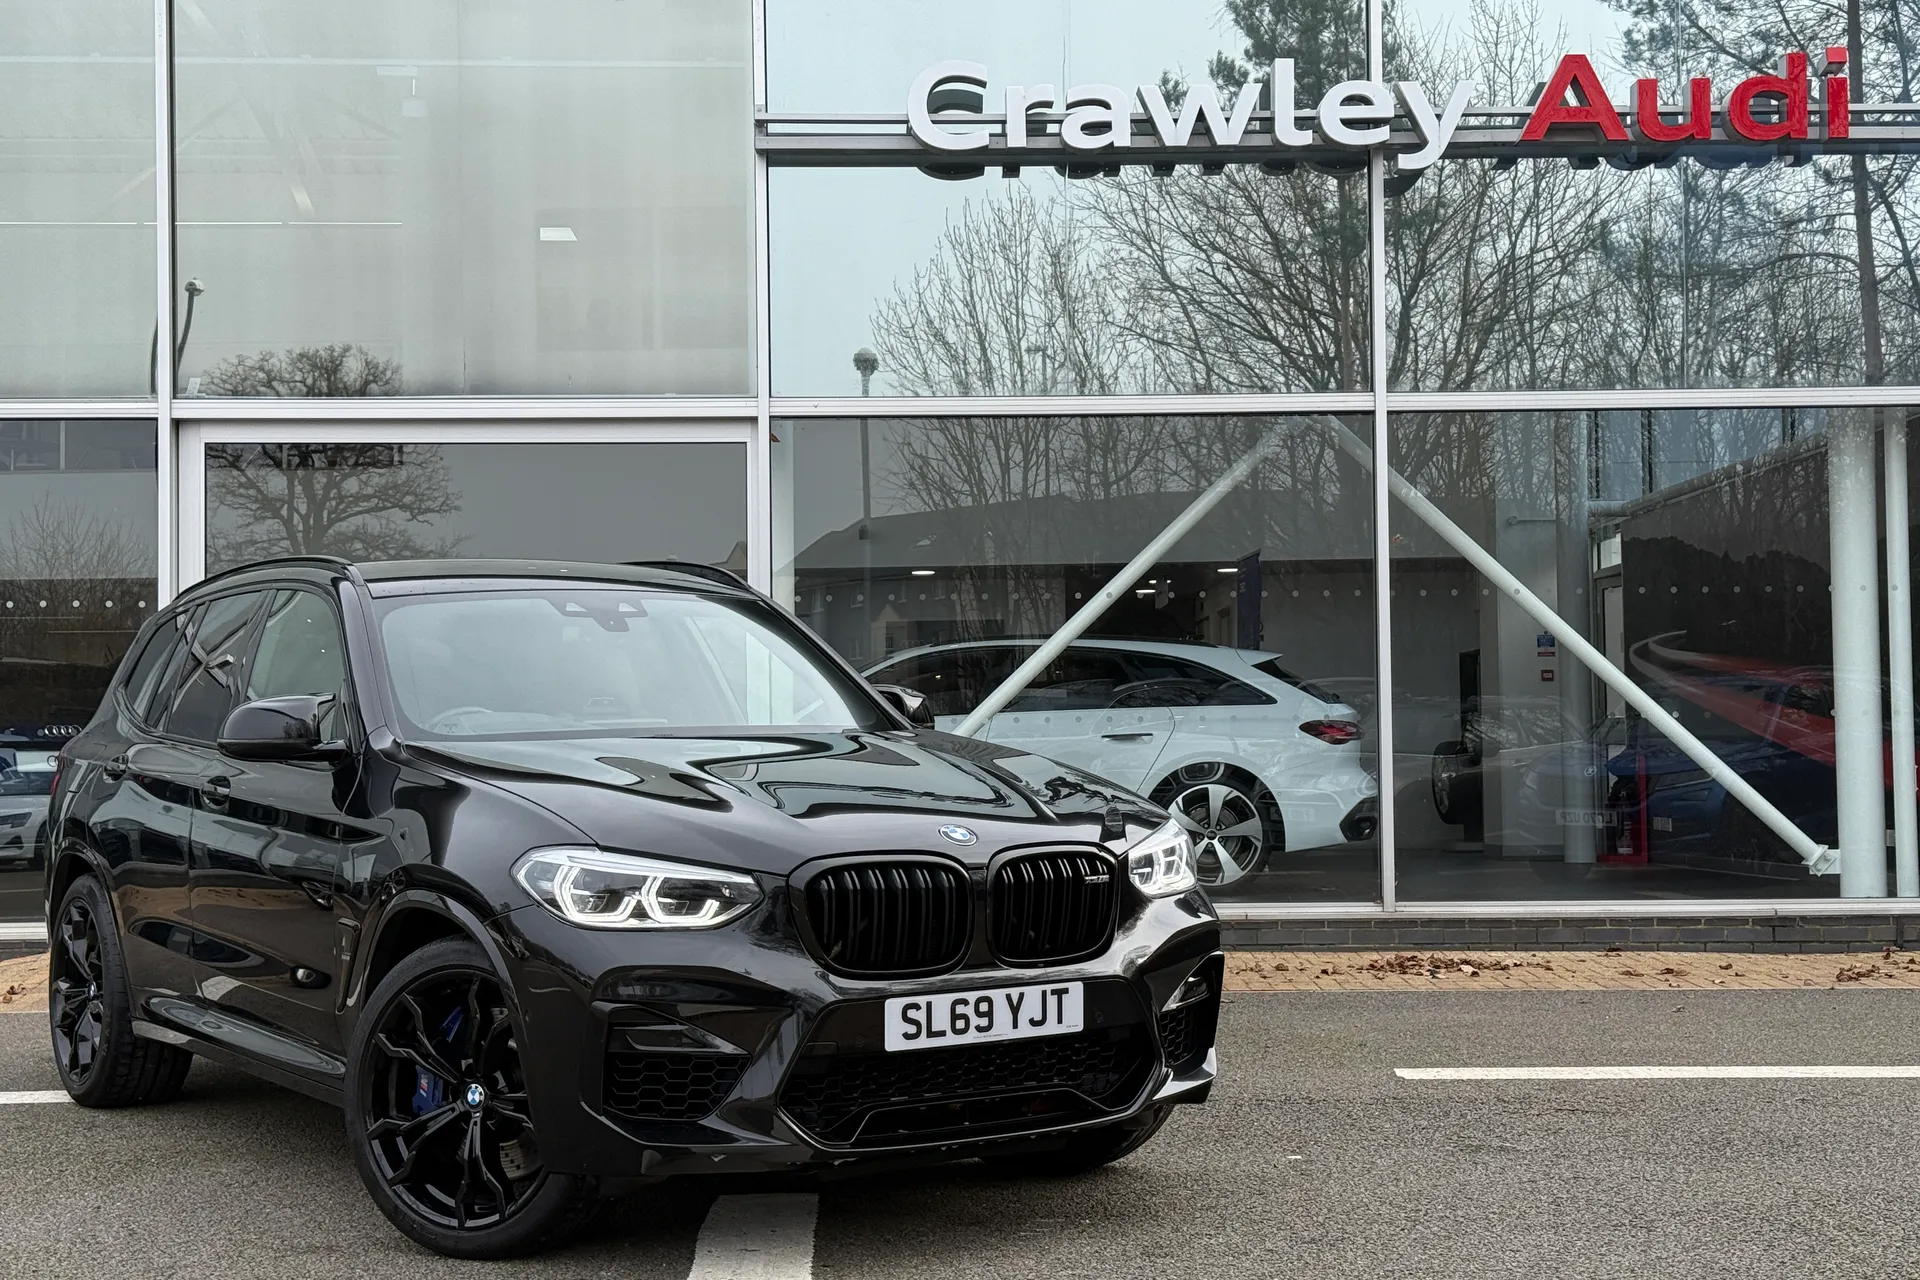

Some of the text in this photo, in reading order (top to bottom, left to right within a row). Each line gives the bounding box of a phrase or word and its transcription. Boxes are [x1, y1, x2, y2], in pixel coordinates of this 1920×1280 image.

[907, 46, 1849, 171] Crawley Audi
[901, 987, 1070, 1041] SL69 YJT
